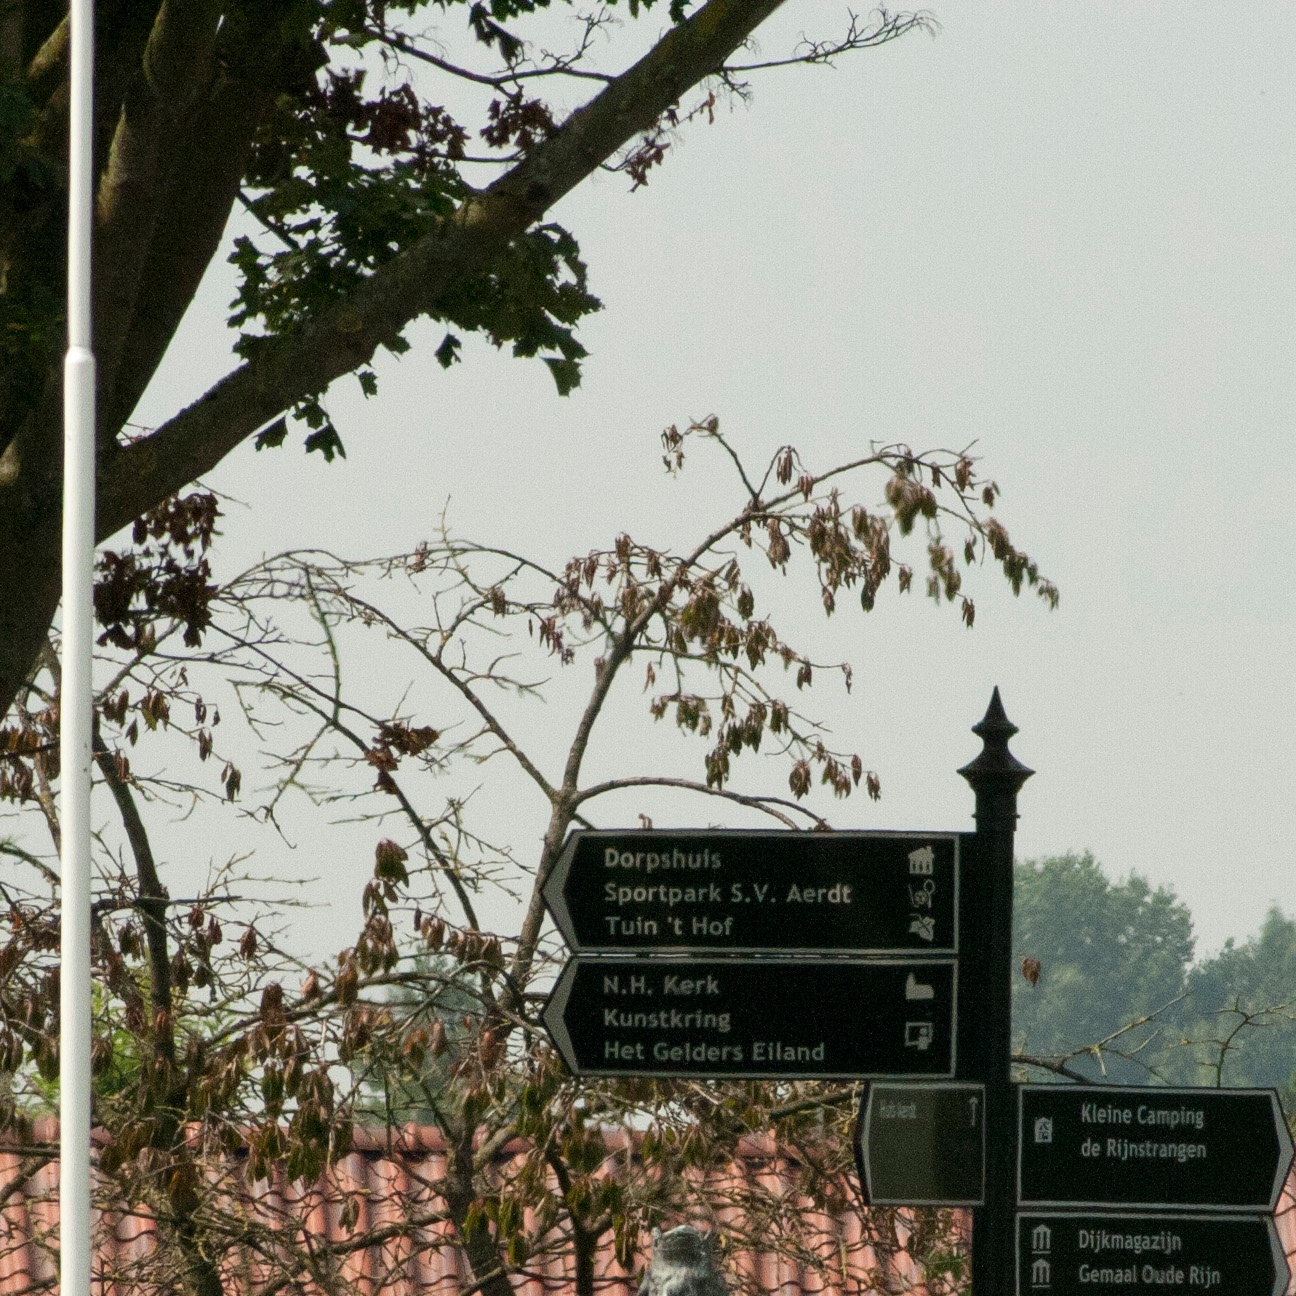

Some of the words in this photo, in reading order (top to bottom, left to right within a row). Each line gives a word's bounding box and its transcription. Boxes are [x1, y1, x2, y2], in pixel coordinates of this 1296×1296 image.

[604, 847, 721, 873] Dorpshuis
[604, 882, 721, 907] Sportpark
[730, 882, 777, 904] S.V.
[786, 883, 852, 904] Aerdt
[605, 915, 658, 936] Tuin
[691, 916, 734, 936] Hof
[603, 975, 653, 996] N.H.
[663, 974, 720, 995] Kerk
[603, 1008, 731, 1033] Kunstkring
[604, 1040, 645, 1060] Het
[652, 1041, 744, 1062] Gelders
[752, 1041, 825, 1062] Eiland
[1080, 1103, 1133, 1125] Kleine
[1136, 1104, 1205, 1130] Camping
[1080, 1137, 1102, 1158] de
[1106, 1137, 1207, 1163] Rijnstrangen
[1078, 1229, 1182, 1255] Dijkmagazijn
[1078, 1263, 1138, 1284] Gemaal
[1141, 1264, 1185, 1285] Oude
[1188, 1265, 1221, 1289] Rijn
